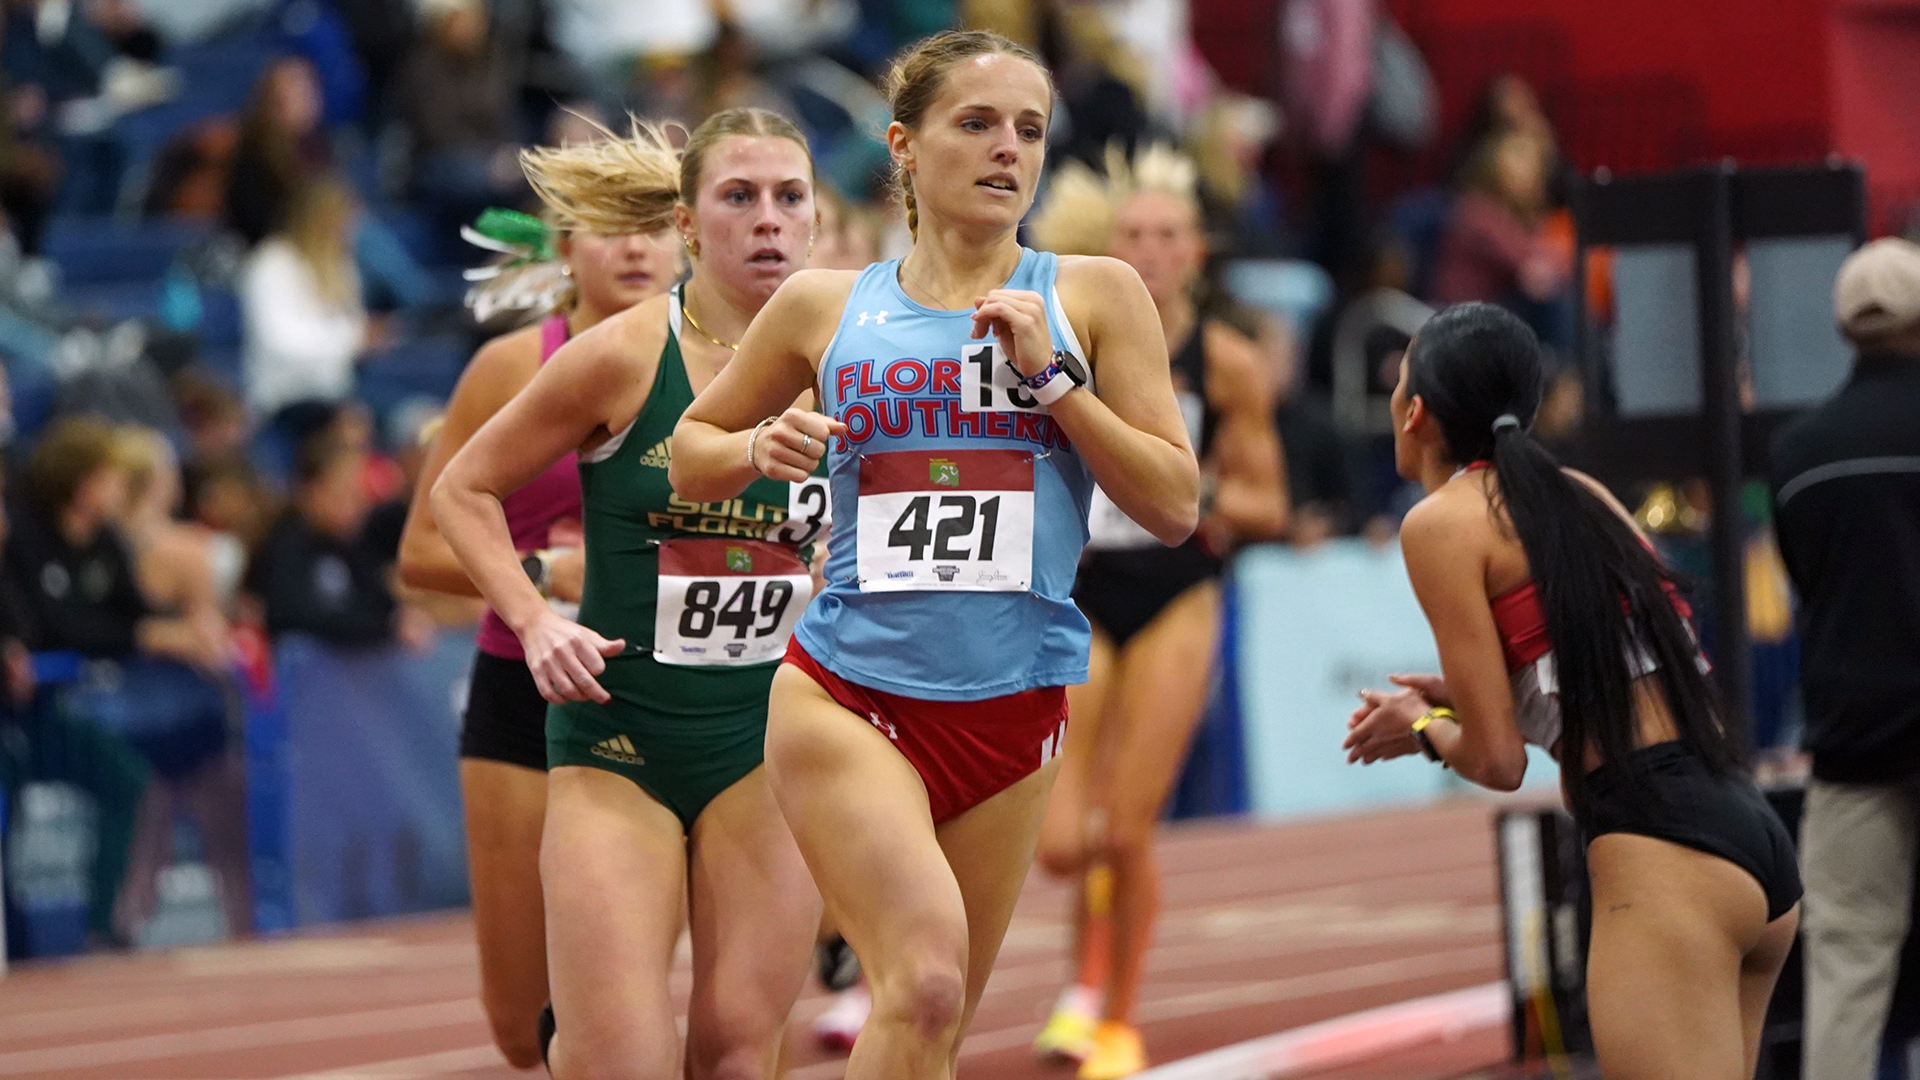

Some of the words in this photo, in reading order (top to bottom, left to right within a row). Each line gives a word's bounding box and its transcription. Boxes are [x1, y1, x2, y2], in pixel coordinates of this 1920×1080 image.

[835, 358, 961, 407] FLOR
[647, 511, 769, 539] FLORI
[667, 492, 788, 524] SOUT
[777, 484, 827, 547] 3
[887, 495, 1001, 561] 421
[678, 580, 793, 639] 849
[589, 745, 647, 766] adidas
